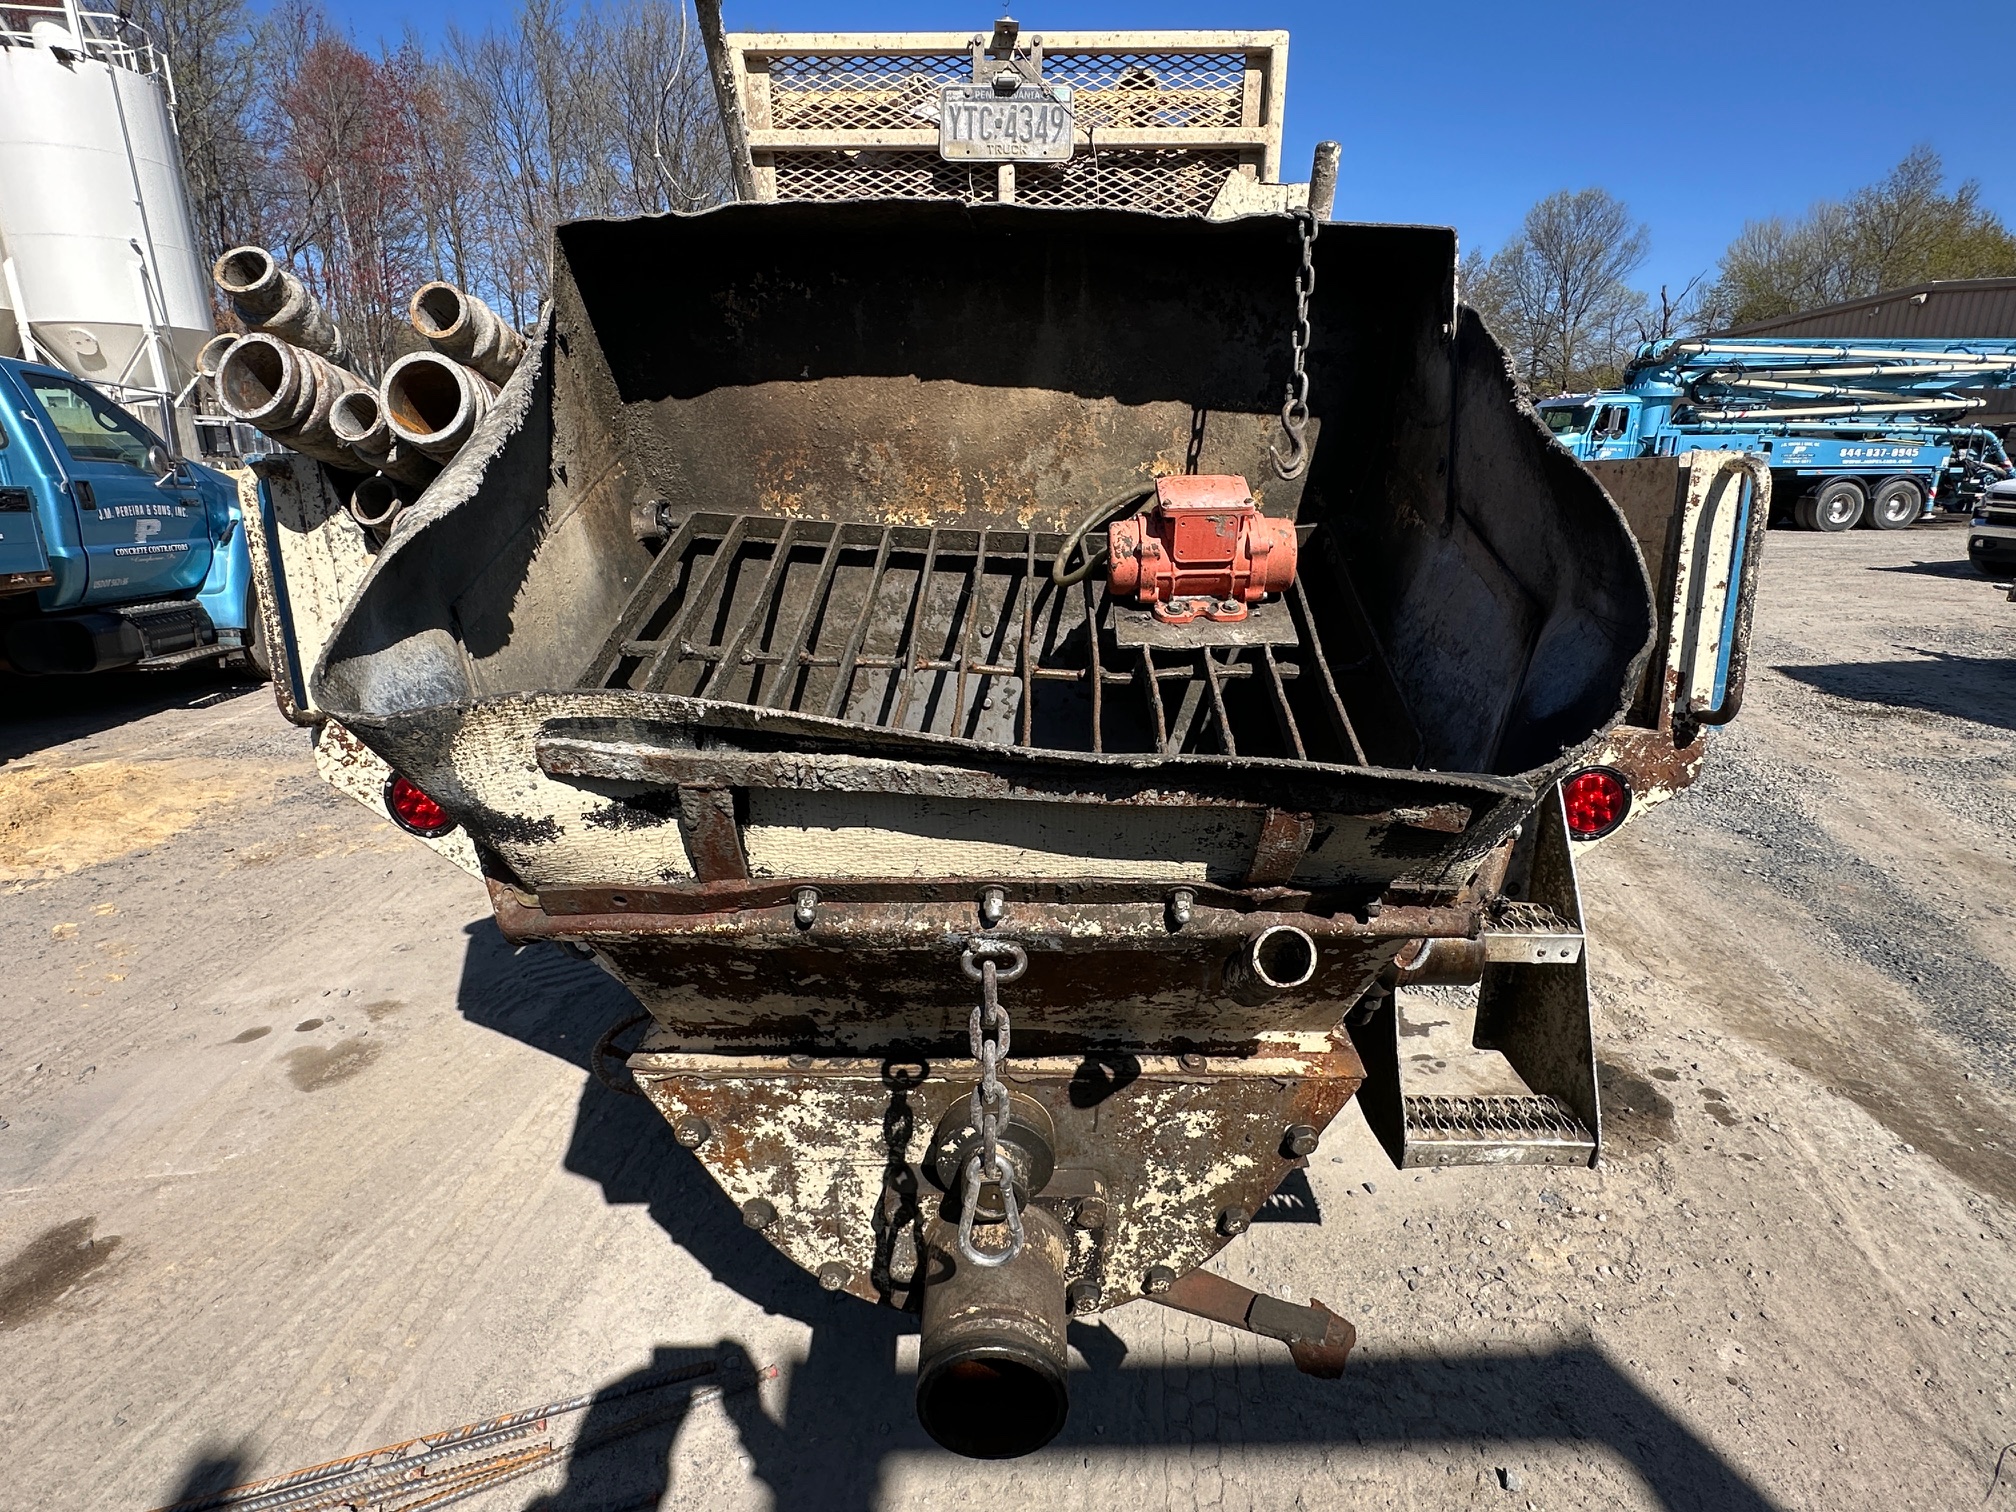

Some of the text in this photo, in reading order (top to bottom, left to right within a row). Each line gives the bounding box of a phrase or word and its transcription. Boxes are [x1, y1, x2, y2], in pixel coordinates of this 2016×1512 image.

[986, 144, 1027, 155] TRUCK
[114, 505, 145, 518] PEREIRA
[115, 543, 189, 556] CONCRETE CONTRACTORS
